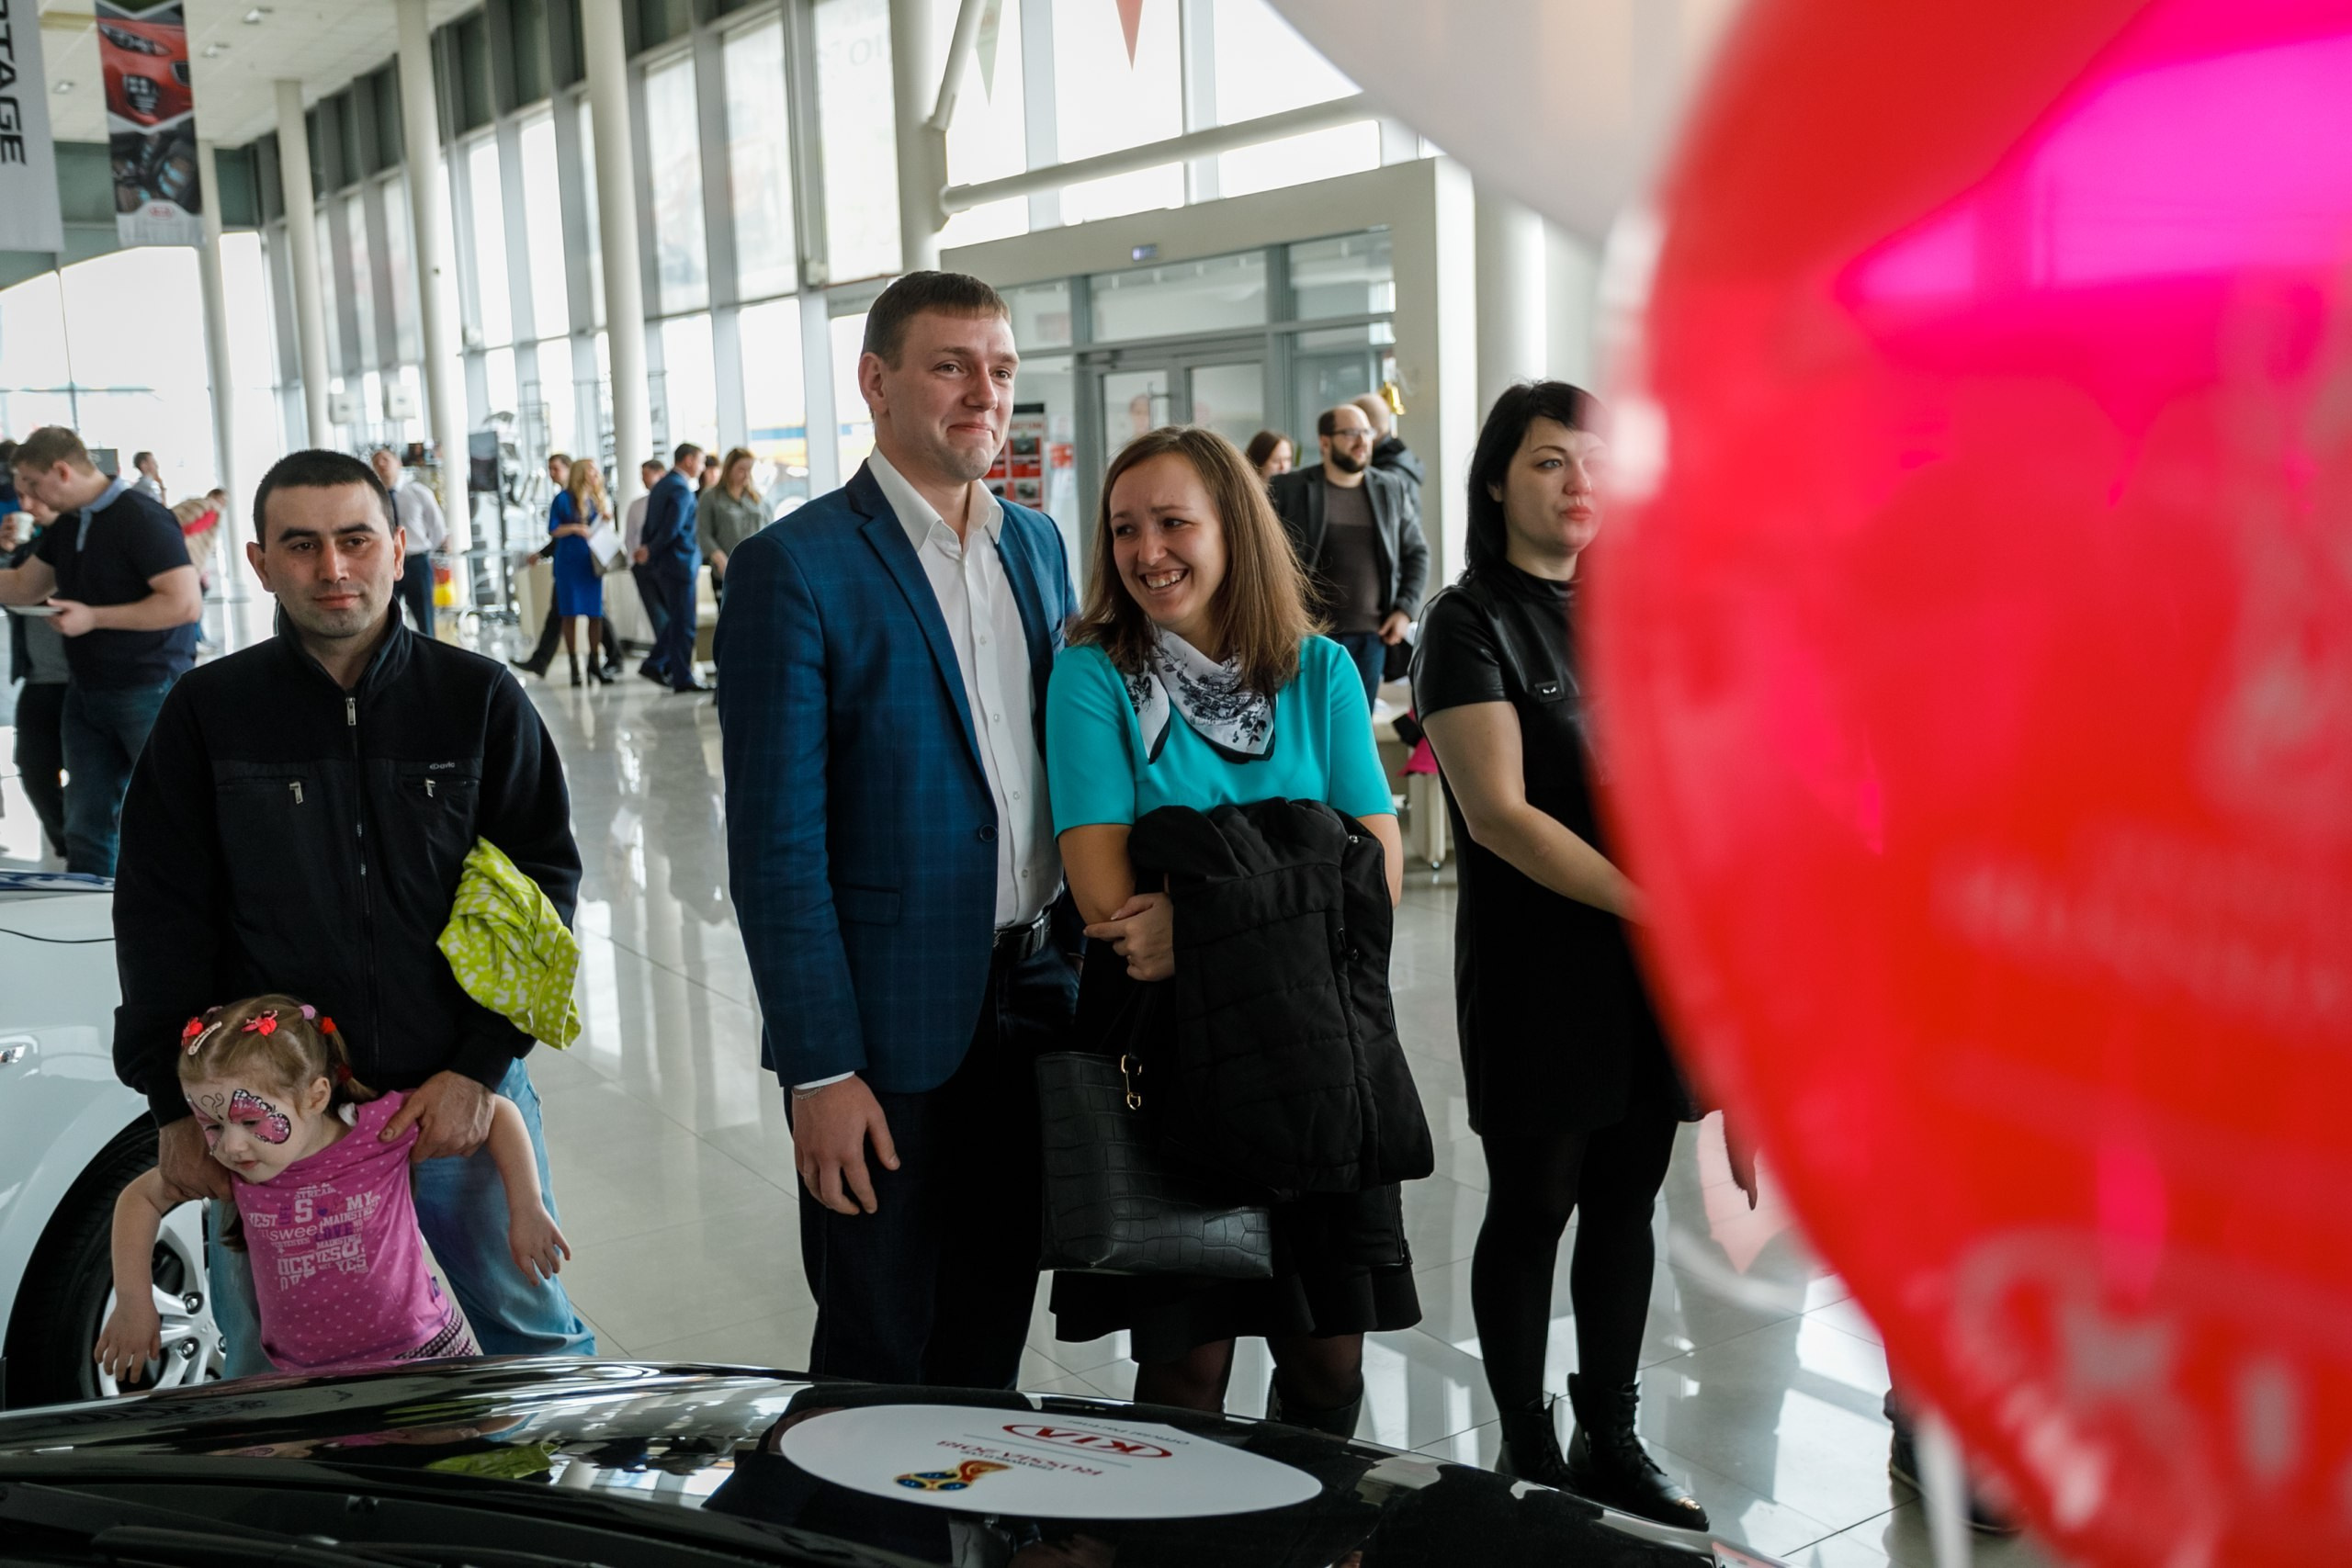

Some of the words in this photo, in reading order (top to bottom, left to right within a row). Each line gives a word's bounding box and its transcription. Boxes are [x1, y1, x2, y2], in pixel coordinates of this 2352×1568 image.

[269, 1220, 324, 1242] sweet
[314, 1222, 355, 1242] LOVE
[315, 1246, 342, 1263] YES
[335, 1253, 367, 1272] YES
[935, 1439, 1001, 1454] 2018
[1035, 1426, 1148, 1454] KIA
[1002, 1451, 1103, 1476] RUSSIA
